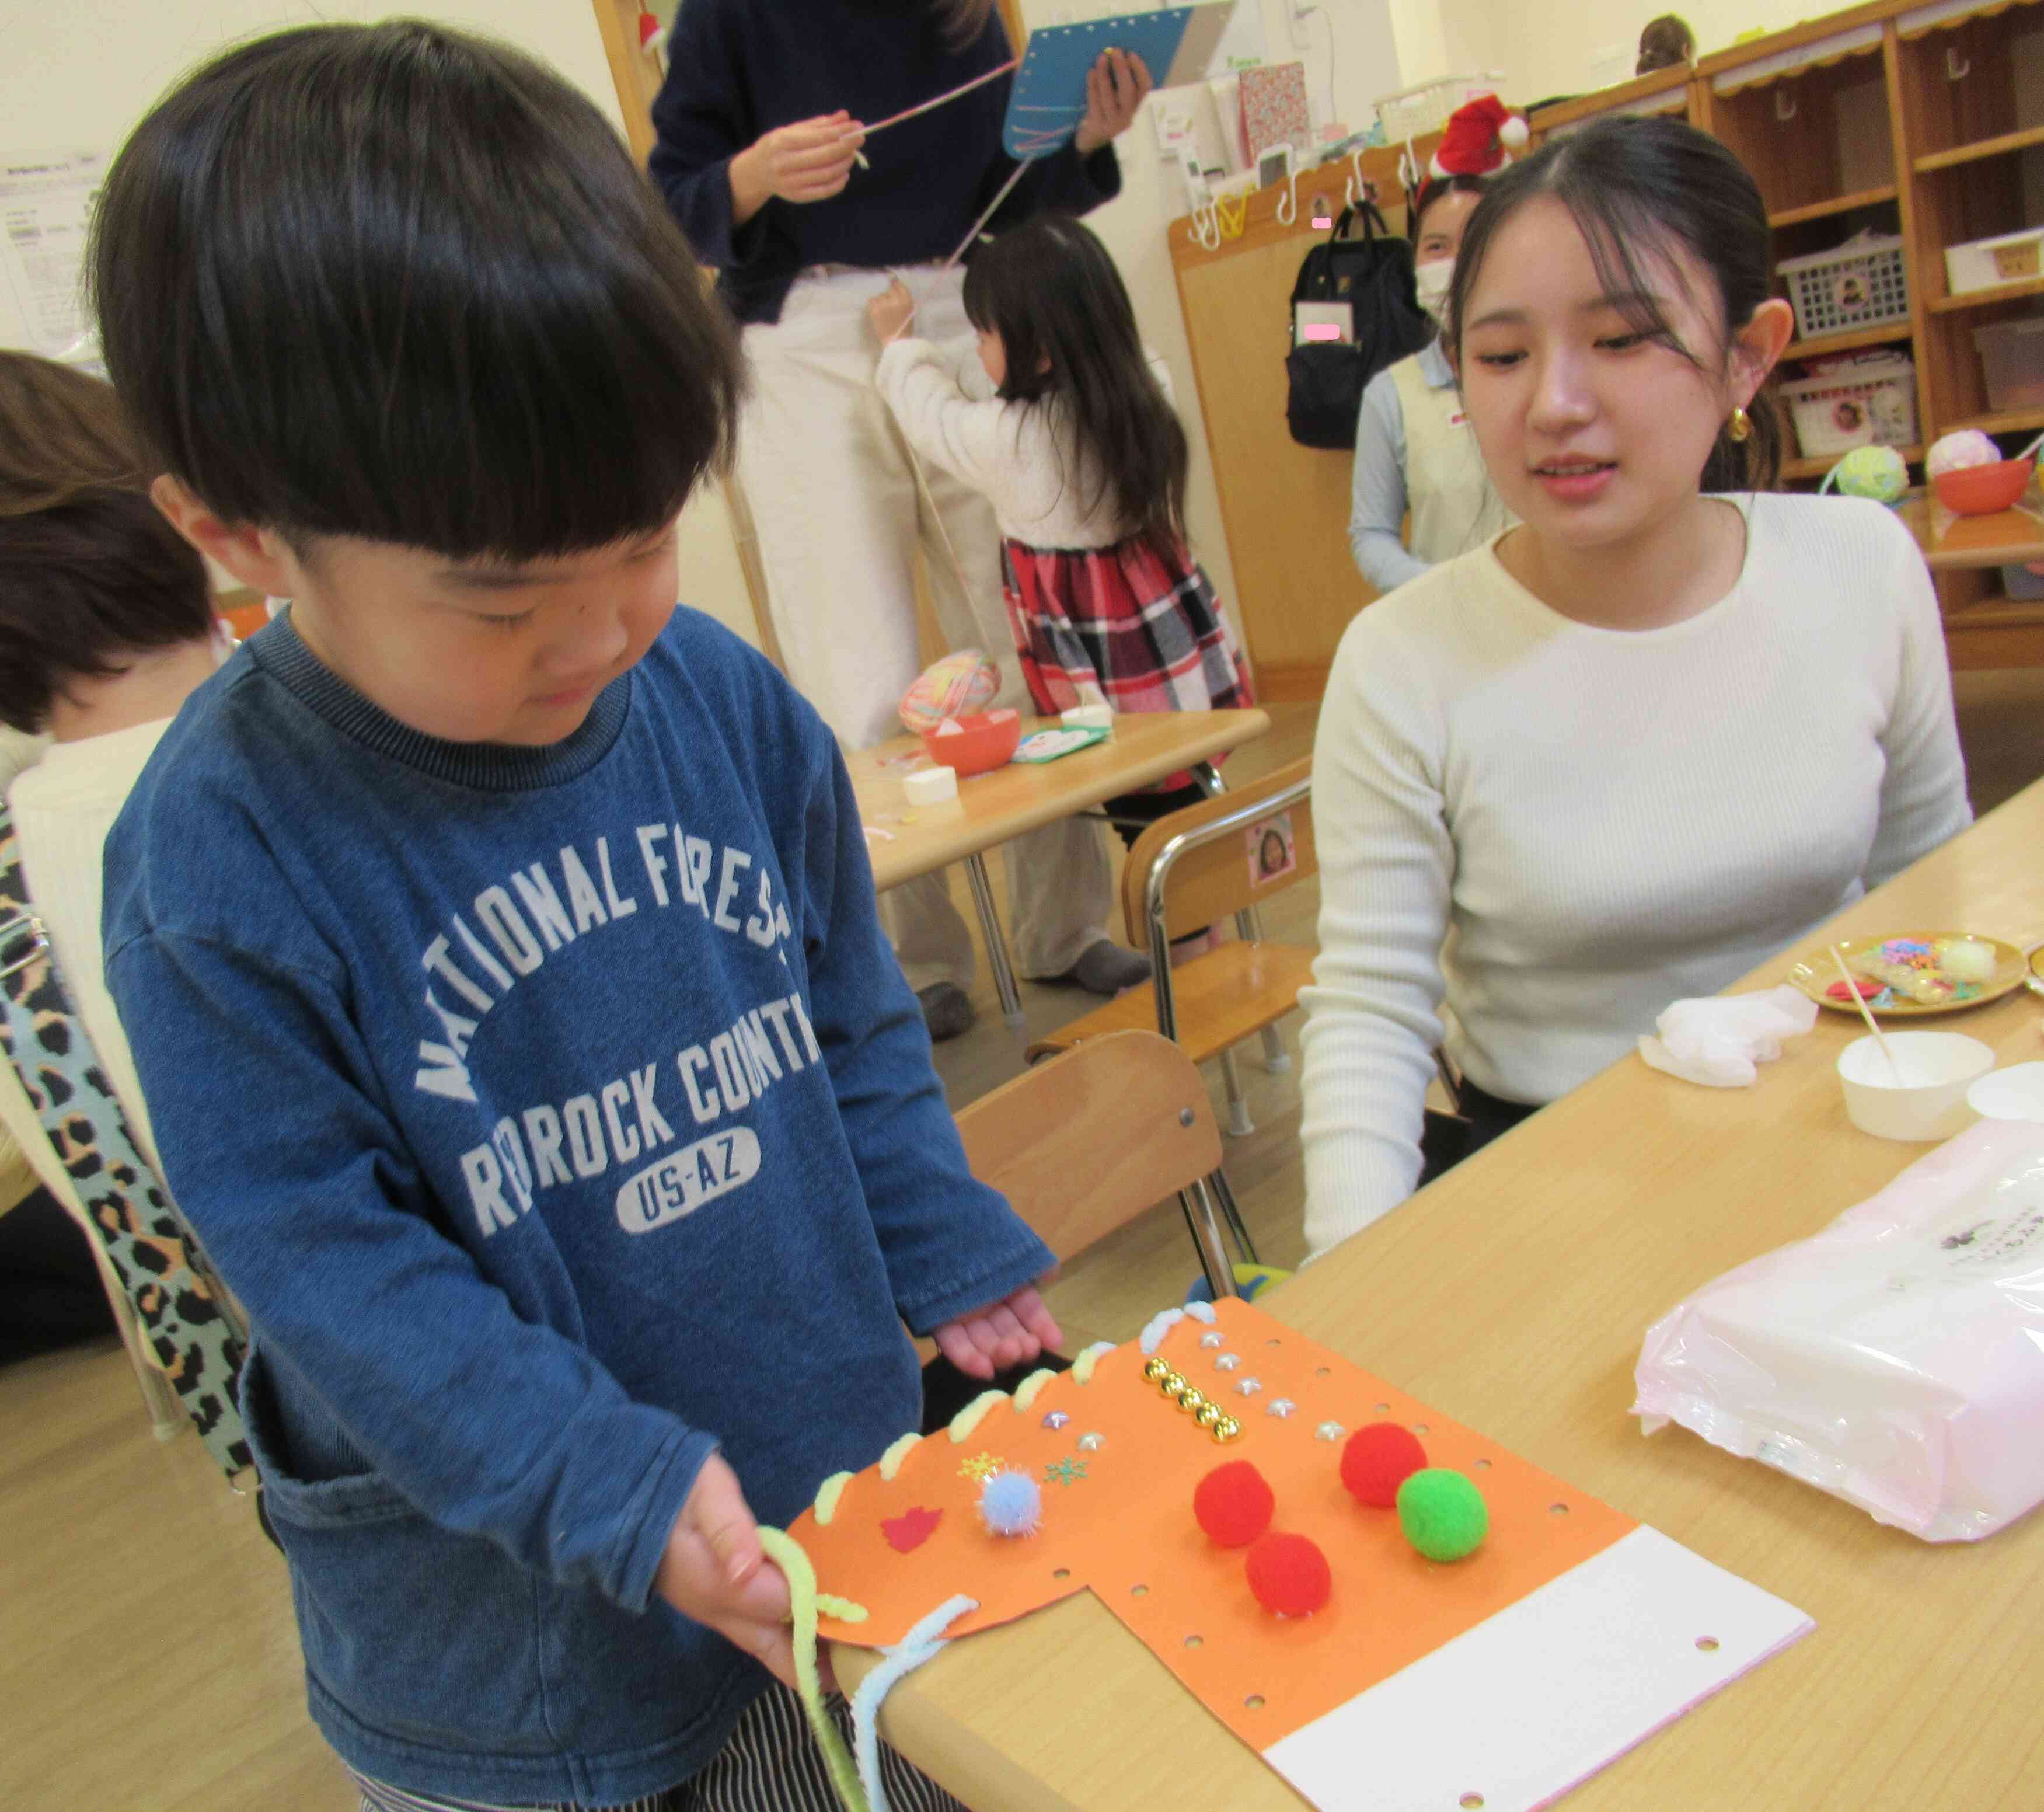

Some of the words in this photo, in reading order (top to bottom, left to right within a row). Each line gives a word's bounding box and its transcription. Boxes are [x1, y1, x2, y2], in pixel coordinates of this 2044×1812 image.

[415, 837, 638, 1102] NATIONAL
[523, 1061, 675, 1189] ROCK
[637, 1135, 741, 1222] US-AZ
